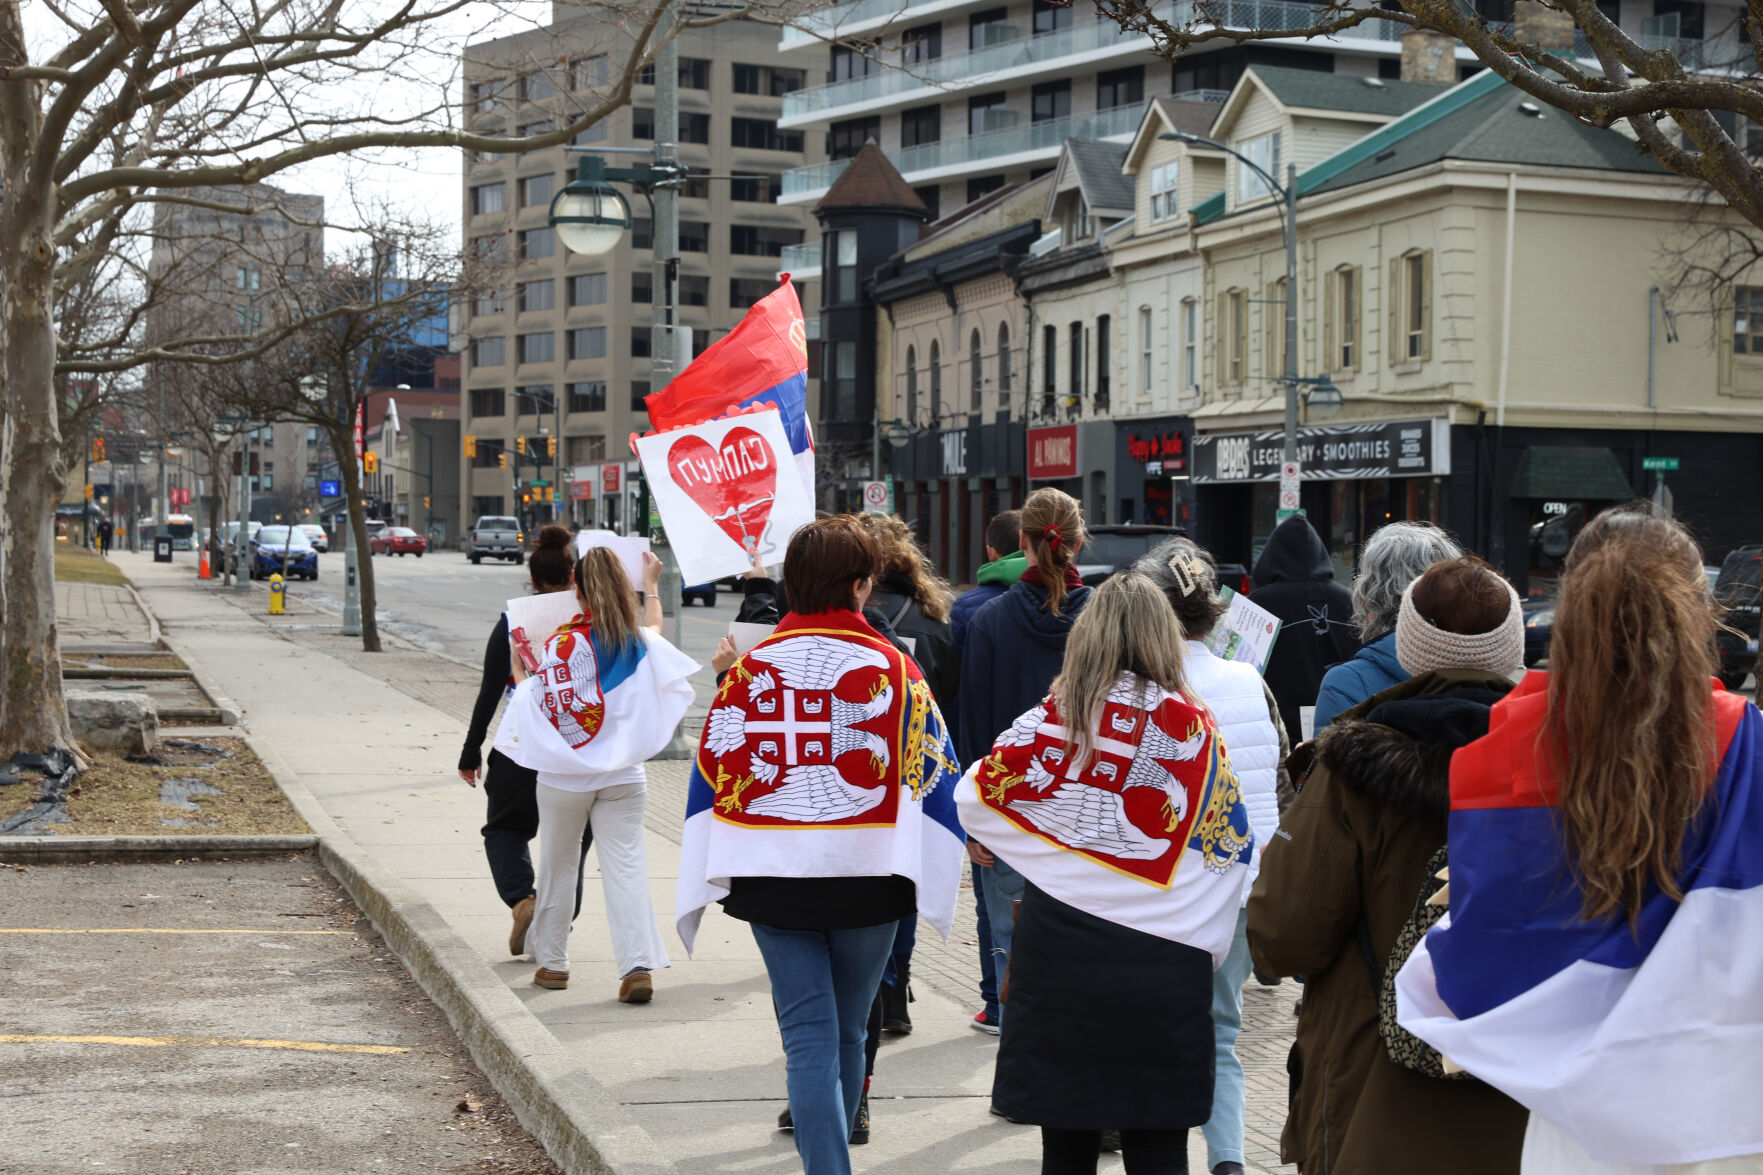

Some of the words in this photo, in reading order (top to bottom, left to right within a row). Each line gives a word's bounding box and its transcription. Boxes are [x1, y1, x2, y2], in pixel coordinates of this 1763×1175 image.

[677, 437, 769, 487] ПУМПАЈ
[1253, 444, 1314, 466] LEGENARY
[1323, 440, 1391, 461] SMOOTHIES
[1543, 502, 1567, 514] OPEN
